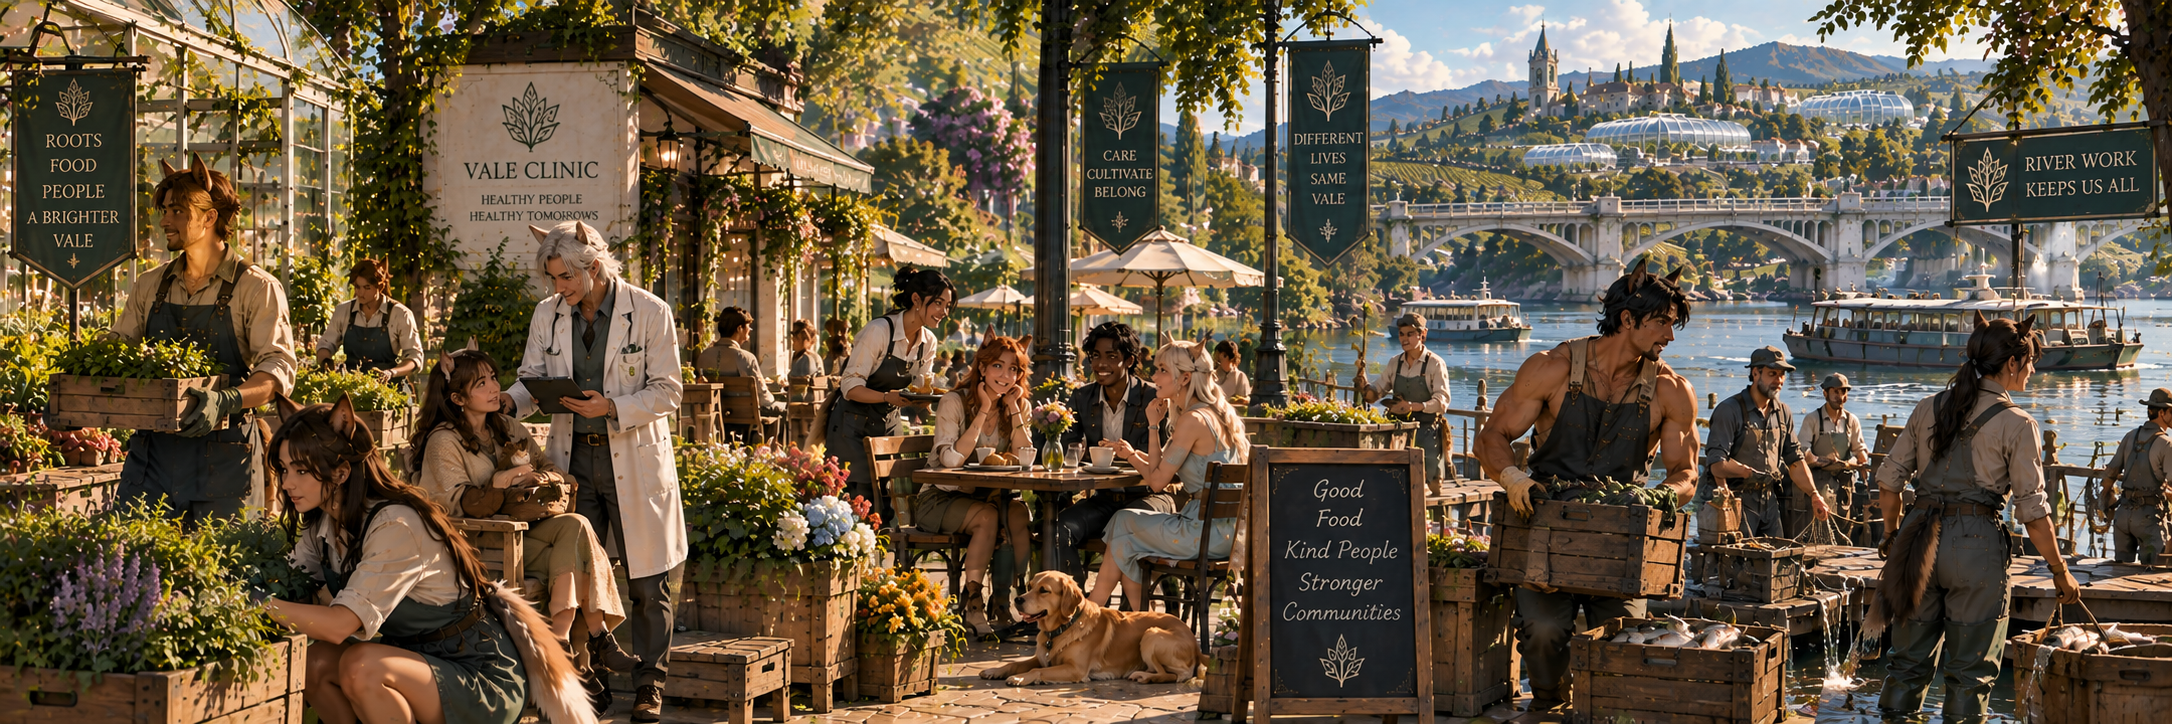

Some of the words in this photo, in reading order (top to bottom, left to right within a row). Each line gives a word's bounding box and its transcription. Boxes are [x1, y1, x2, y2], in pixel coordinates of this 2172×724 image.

[45, 133, 102, 149] ROOTS
[1294, 131, 1364, 146] DIFFERENT
[1103, 149, 1137, 162] CARE
[1310, 151, 1346, 165] LIVES
[2025, 154, 2076, 172] RIVER
[2080, 150, 2138, 169] WORK
[50, 158, 97, 173] FOOD
[463, 161, 518, 180] VALE
[524, 160, 599, 180] CLINIC
[1086, 168, 1153, 180] CULTIVATE
[1310, 172, 1347, 185] SAME
[42, 183, 105, 199] PEOPLE
[1094, 185, 1146, 198] BELONG
[2026, 180, 2076, 198] KEEPS
[2081, 178, 2103, 195] US
[2107, 176, 2140, 193] ALL
[481, 194, 536, 206] HEALTHY
[539, 193, 583, 205] PEOPLE
[1311, 192, 1346, 205] VALE
[26, 211, 38, 225] A
[42, 210, 120, 224] BRIGHTER
[469, 210, 524, 222] HEALTHY
[53, 233, 94, 248] VALE
[1313, 478, 1365, 502] Good
[1316, 507, 1364, 528] Food
[1284, 539, 1332, 559] Kind
[1337, 539, 1398, 565] People
[1298, 571, 1384, 597] Stronger
[1282, 601, 1401, 622] Communities
